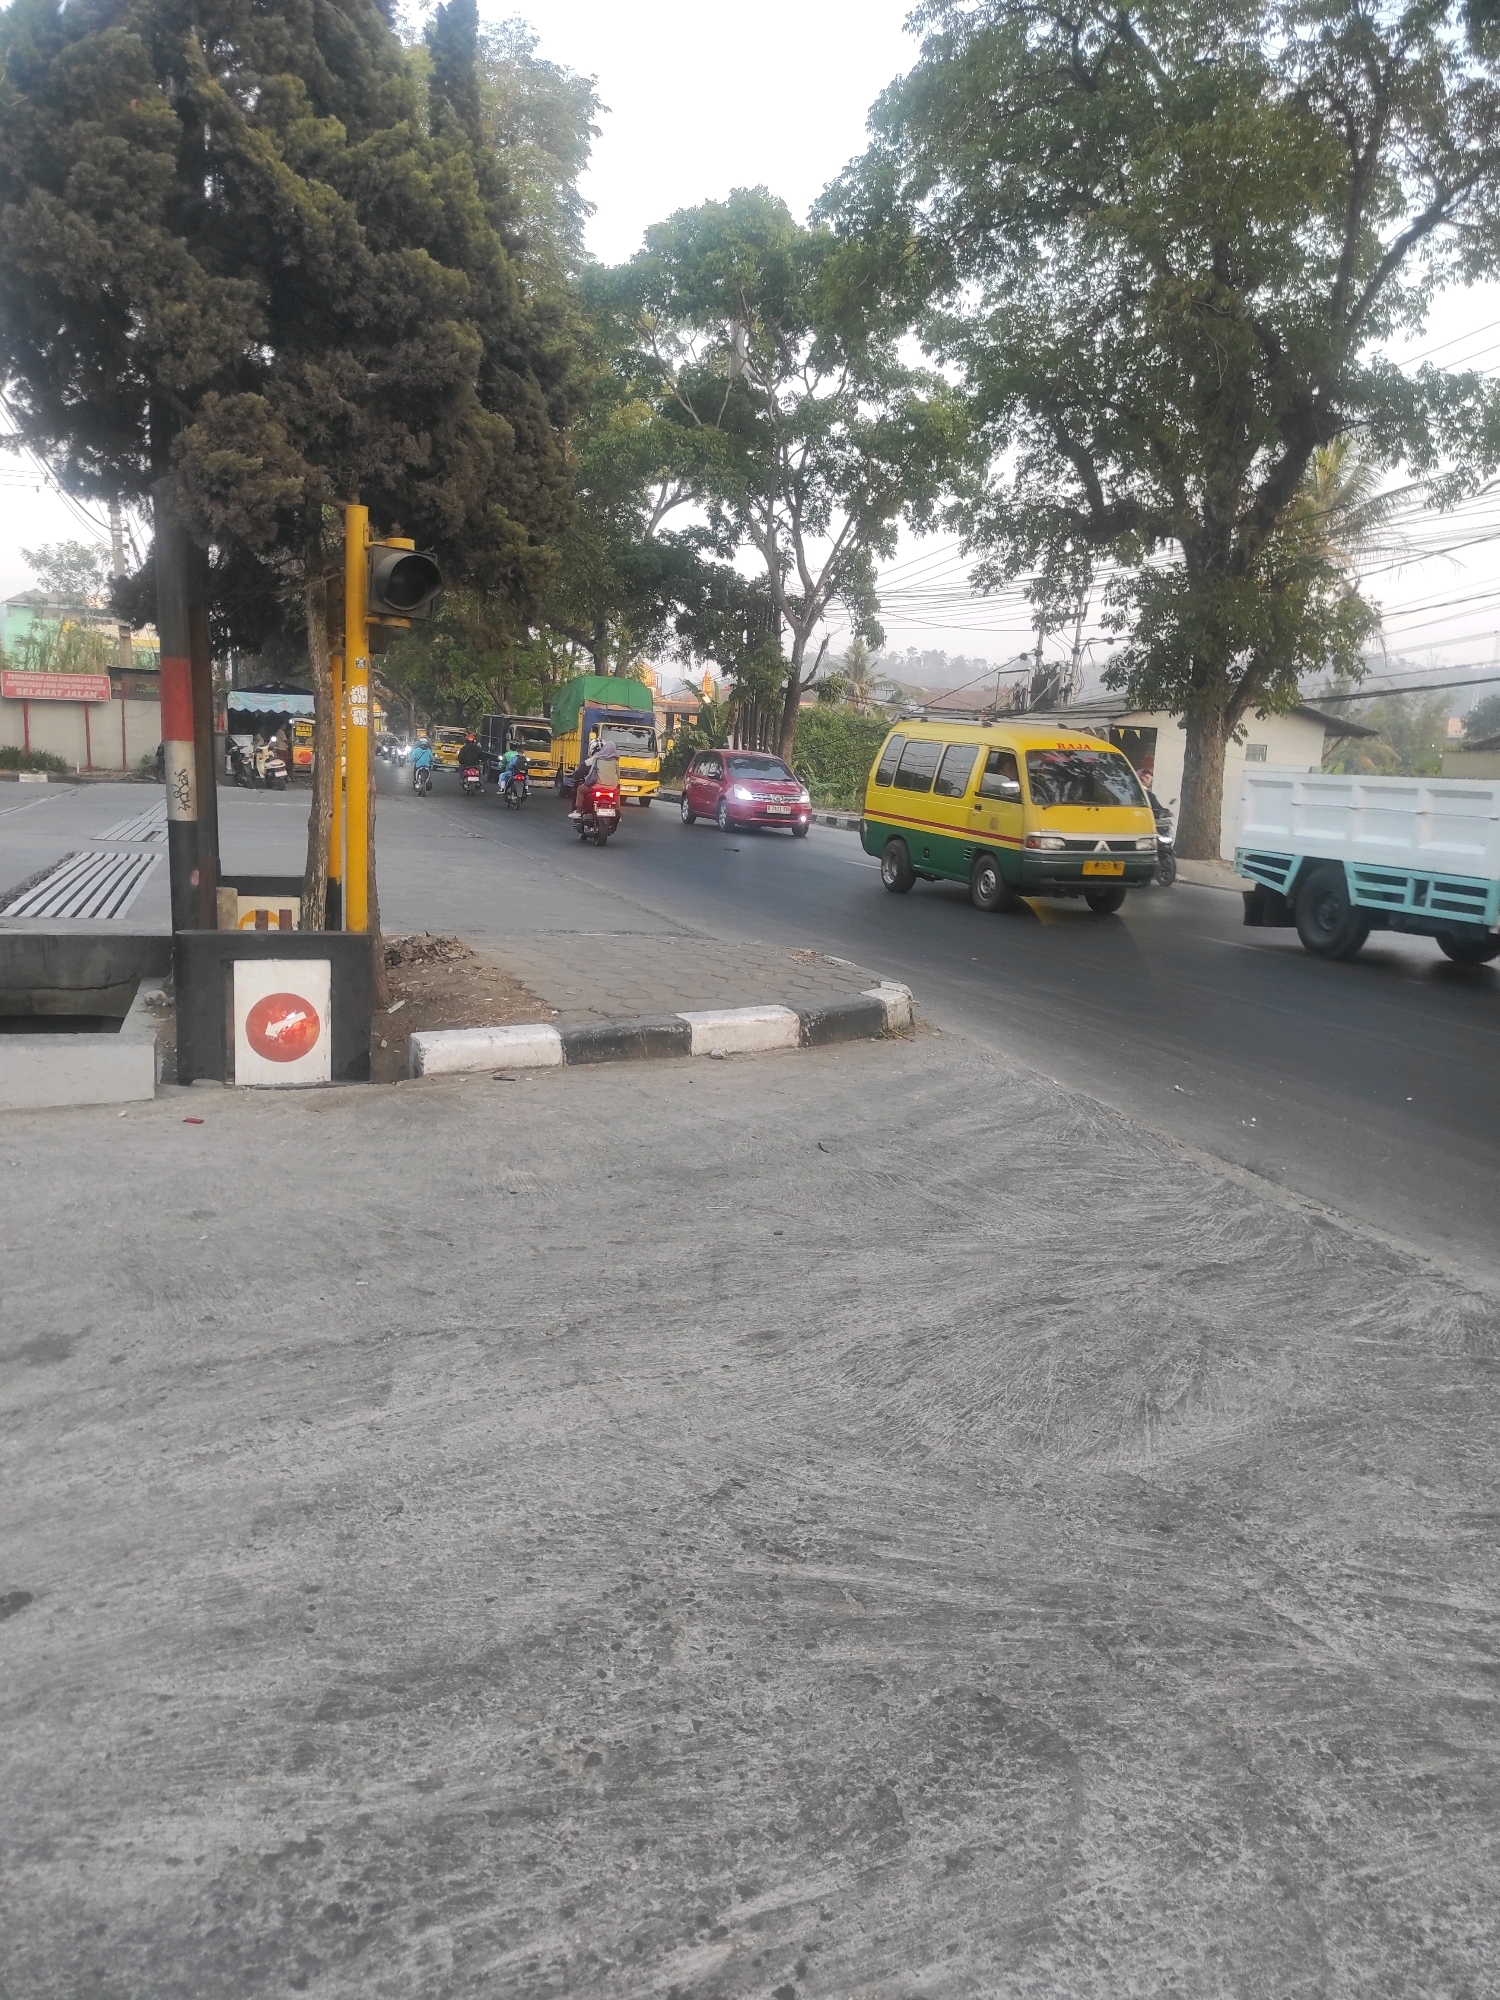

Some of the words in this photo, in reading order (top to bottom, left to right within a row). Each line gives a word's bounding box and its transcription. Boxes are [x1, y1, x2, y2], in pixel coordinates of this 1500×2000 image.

[16, 688, 63, 697] SELAMAT
[65, 690, 97, 698] JALAN
[1056, 742, 1092, 750] RAJA
